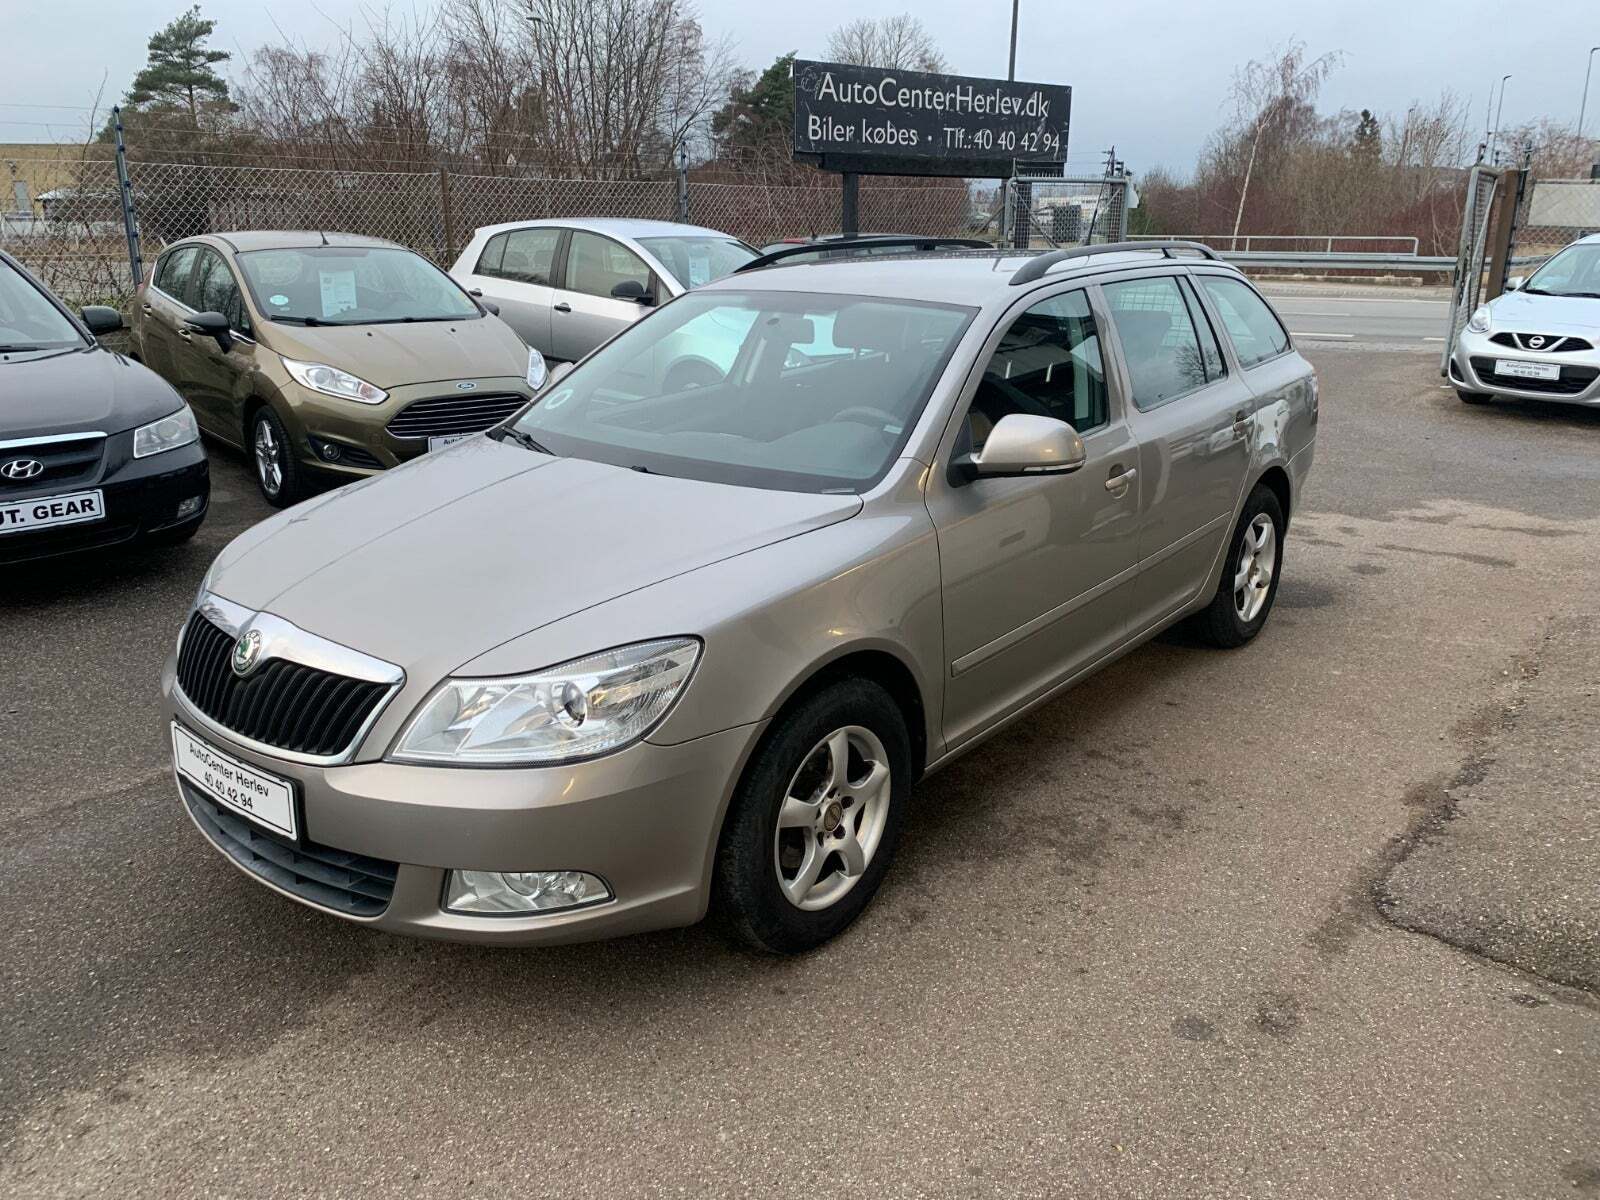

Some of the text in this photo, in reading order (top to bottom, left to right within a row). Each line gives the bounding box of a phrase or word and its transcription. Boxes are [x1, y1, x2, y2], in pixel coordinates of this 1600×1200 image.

[818, 72, 1049, 118] AutoCenterHerlev.dk
[808, 114, 855, 142] Biler
[862, 118, 918, 146] købes
[998, 131, 1016, 151] 40
[1021, 132, 1038, 152] 42
[1043, 132, 1060, 155] 94
[33, 499, 95, 520] GEAR
[190, 743, 269, 797] AutoCenter Herlev
[204, 771, 253, 810] 40 40 42 94
